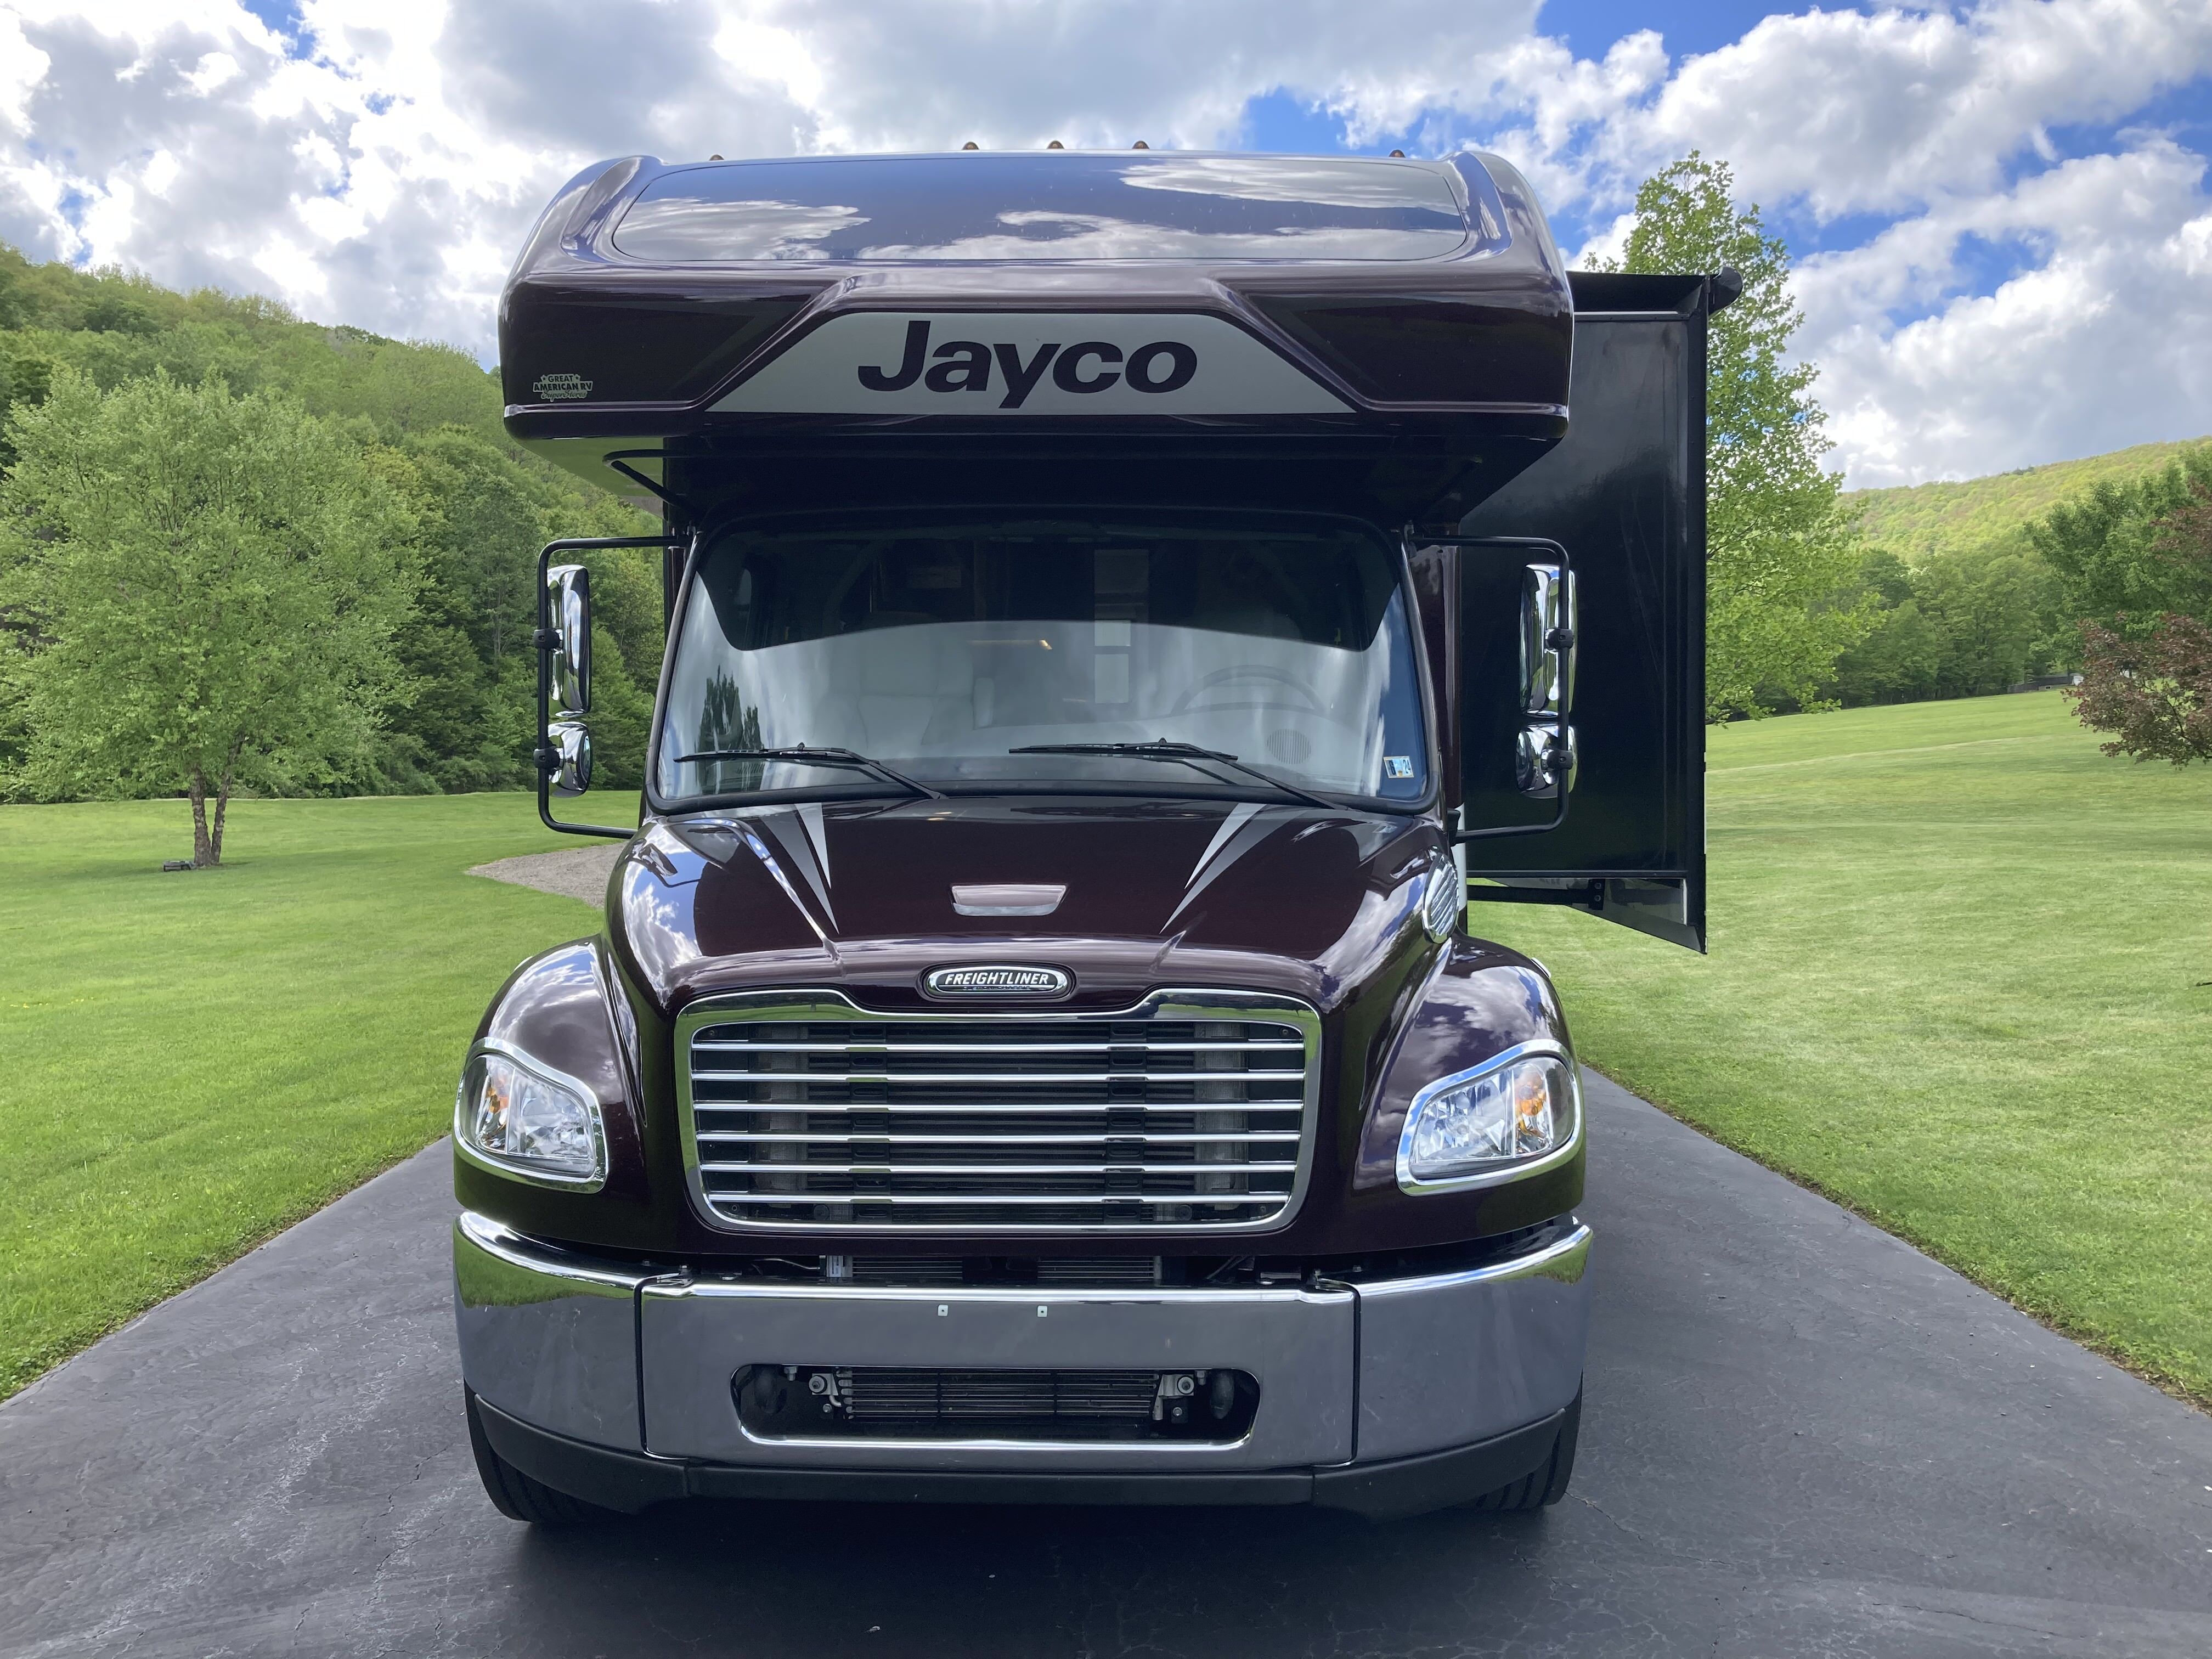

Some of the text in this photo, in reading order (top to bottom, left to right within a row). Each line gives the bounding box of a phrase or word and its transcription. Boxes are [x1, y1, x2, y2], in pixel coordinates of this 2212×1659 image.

[857, 320, 1197, 409] Jayco
[534, 383, 579, 391] AMERICAN
[1403, 759, 1412, 774] 24
[945, 972, 1048, 984] FREIGHTLINER
